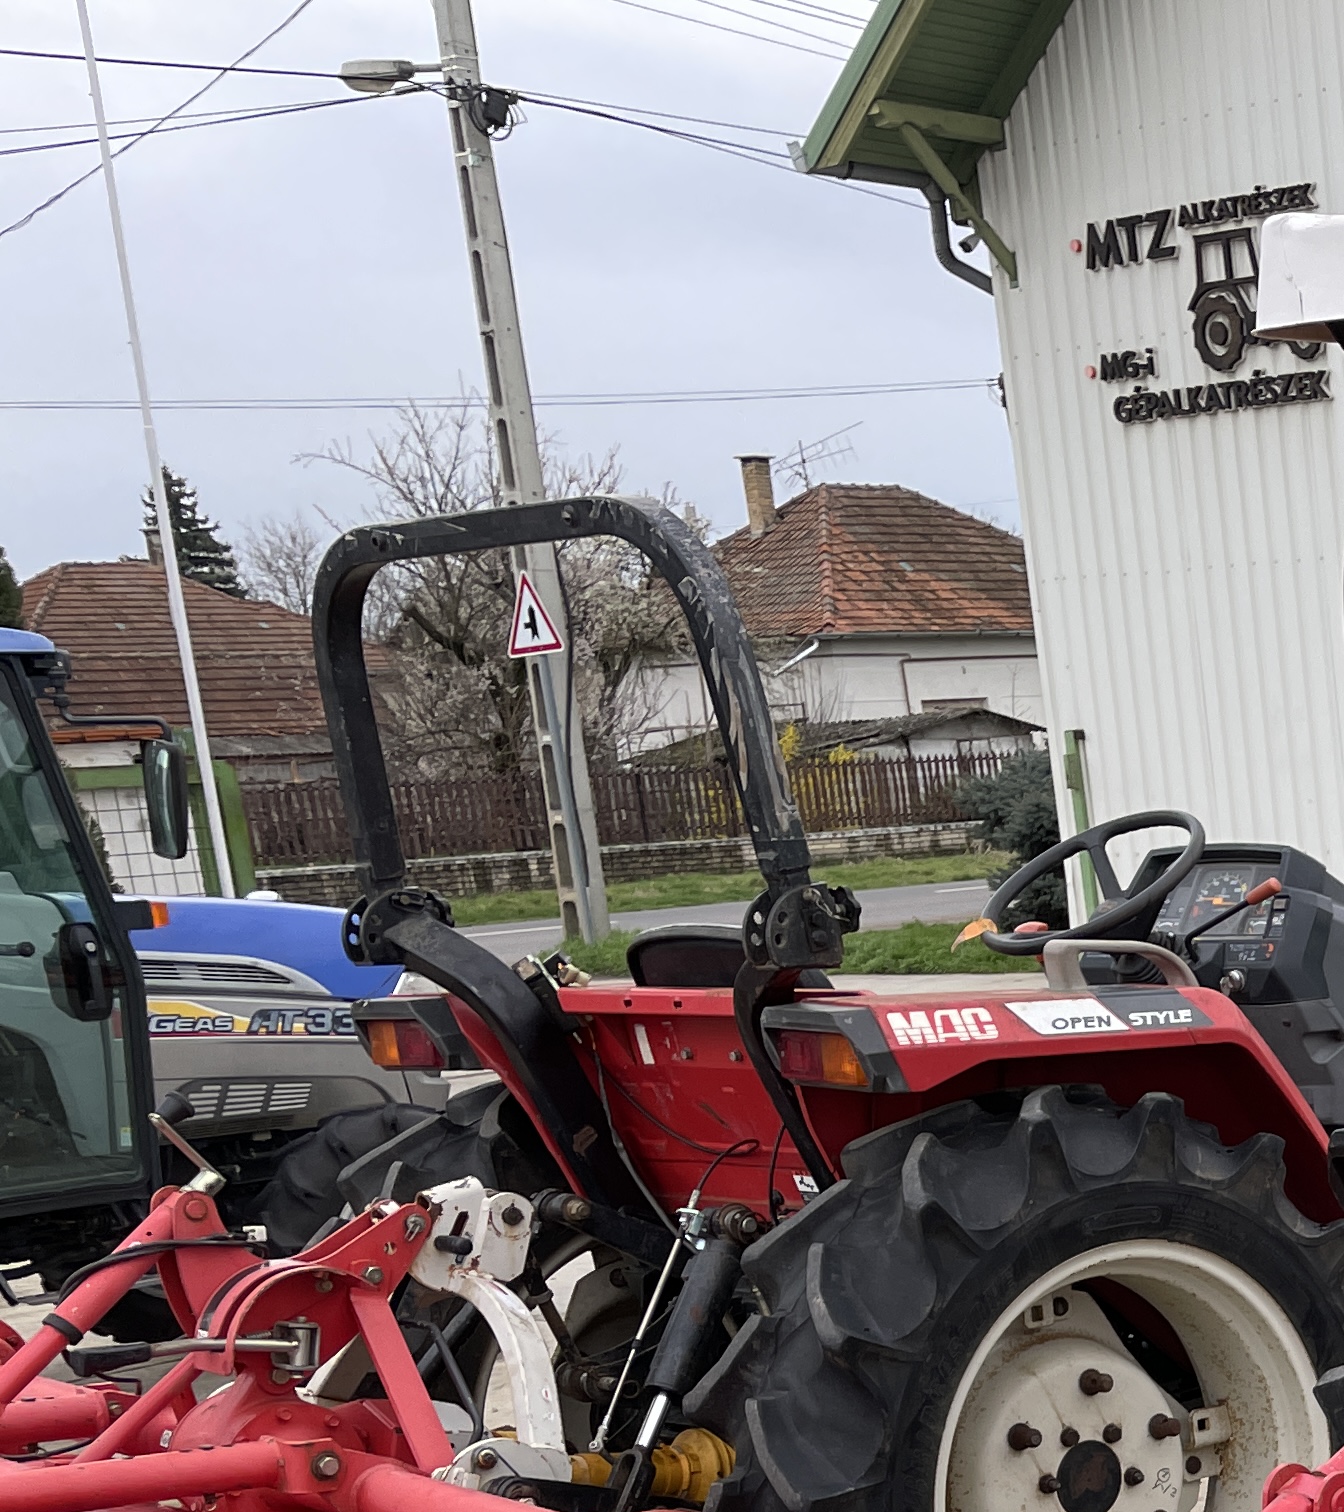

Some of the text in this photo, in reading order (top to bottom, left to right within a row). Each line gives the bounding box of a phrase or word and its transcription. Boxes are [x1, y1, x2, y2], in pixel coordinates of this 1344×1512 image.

[1086, 182, 1318, 271] MTZ ALKATRÉSZEK
[1113, 370, 1333, 423] GÉPALKATRÉSZEK
[886, 1007, 1193, 1046] MAC OPEN STYLE
